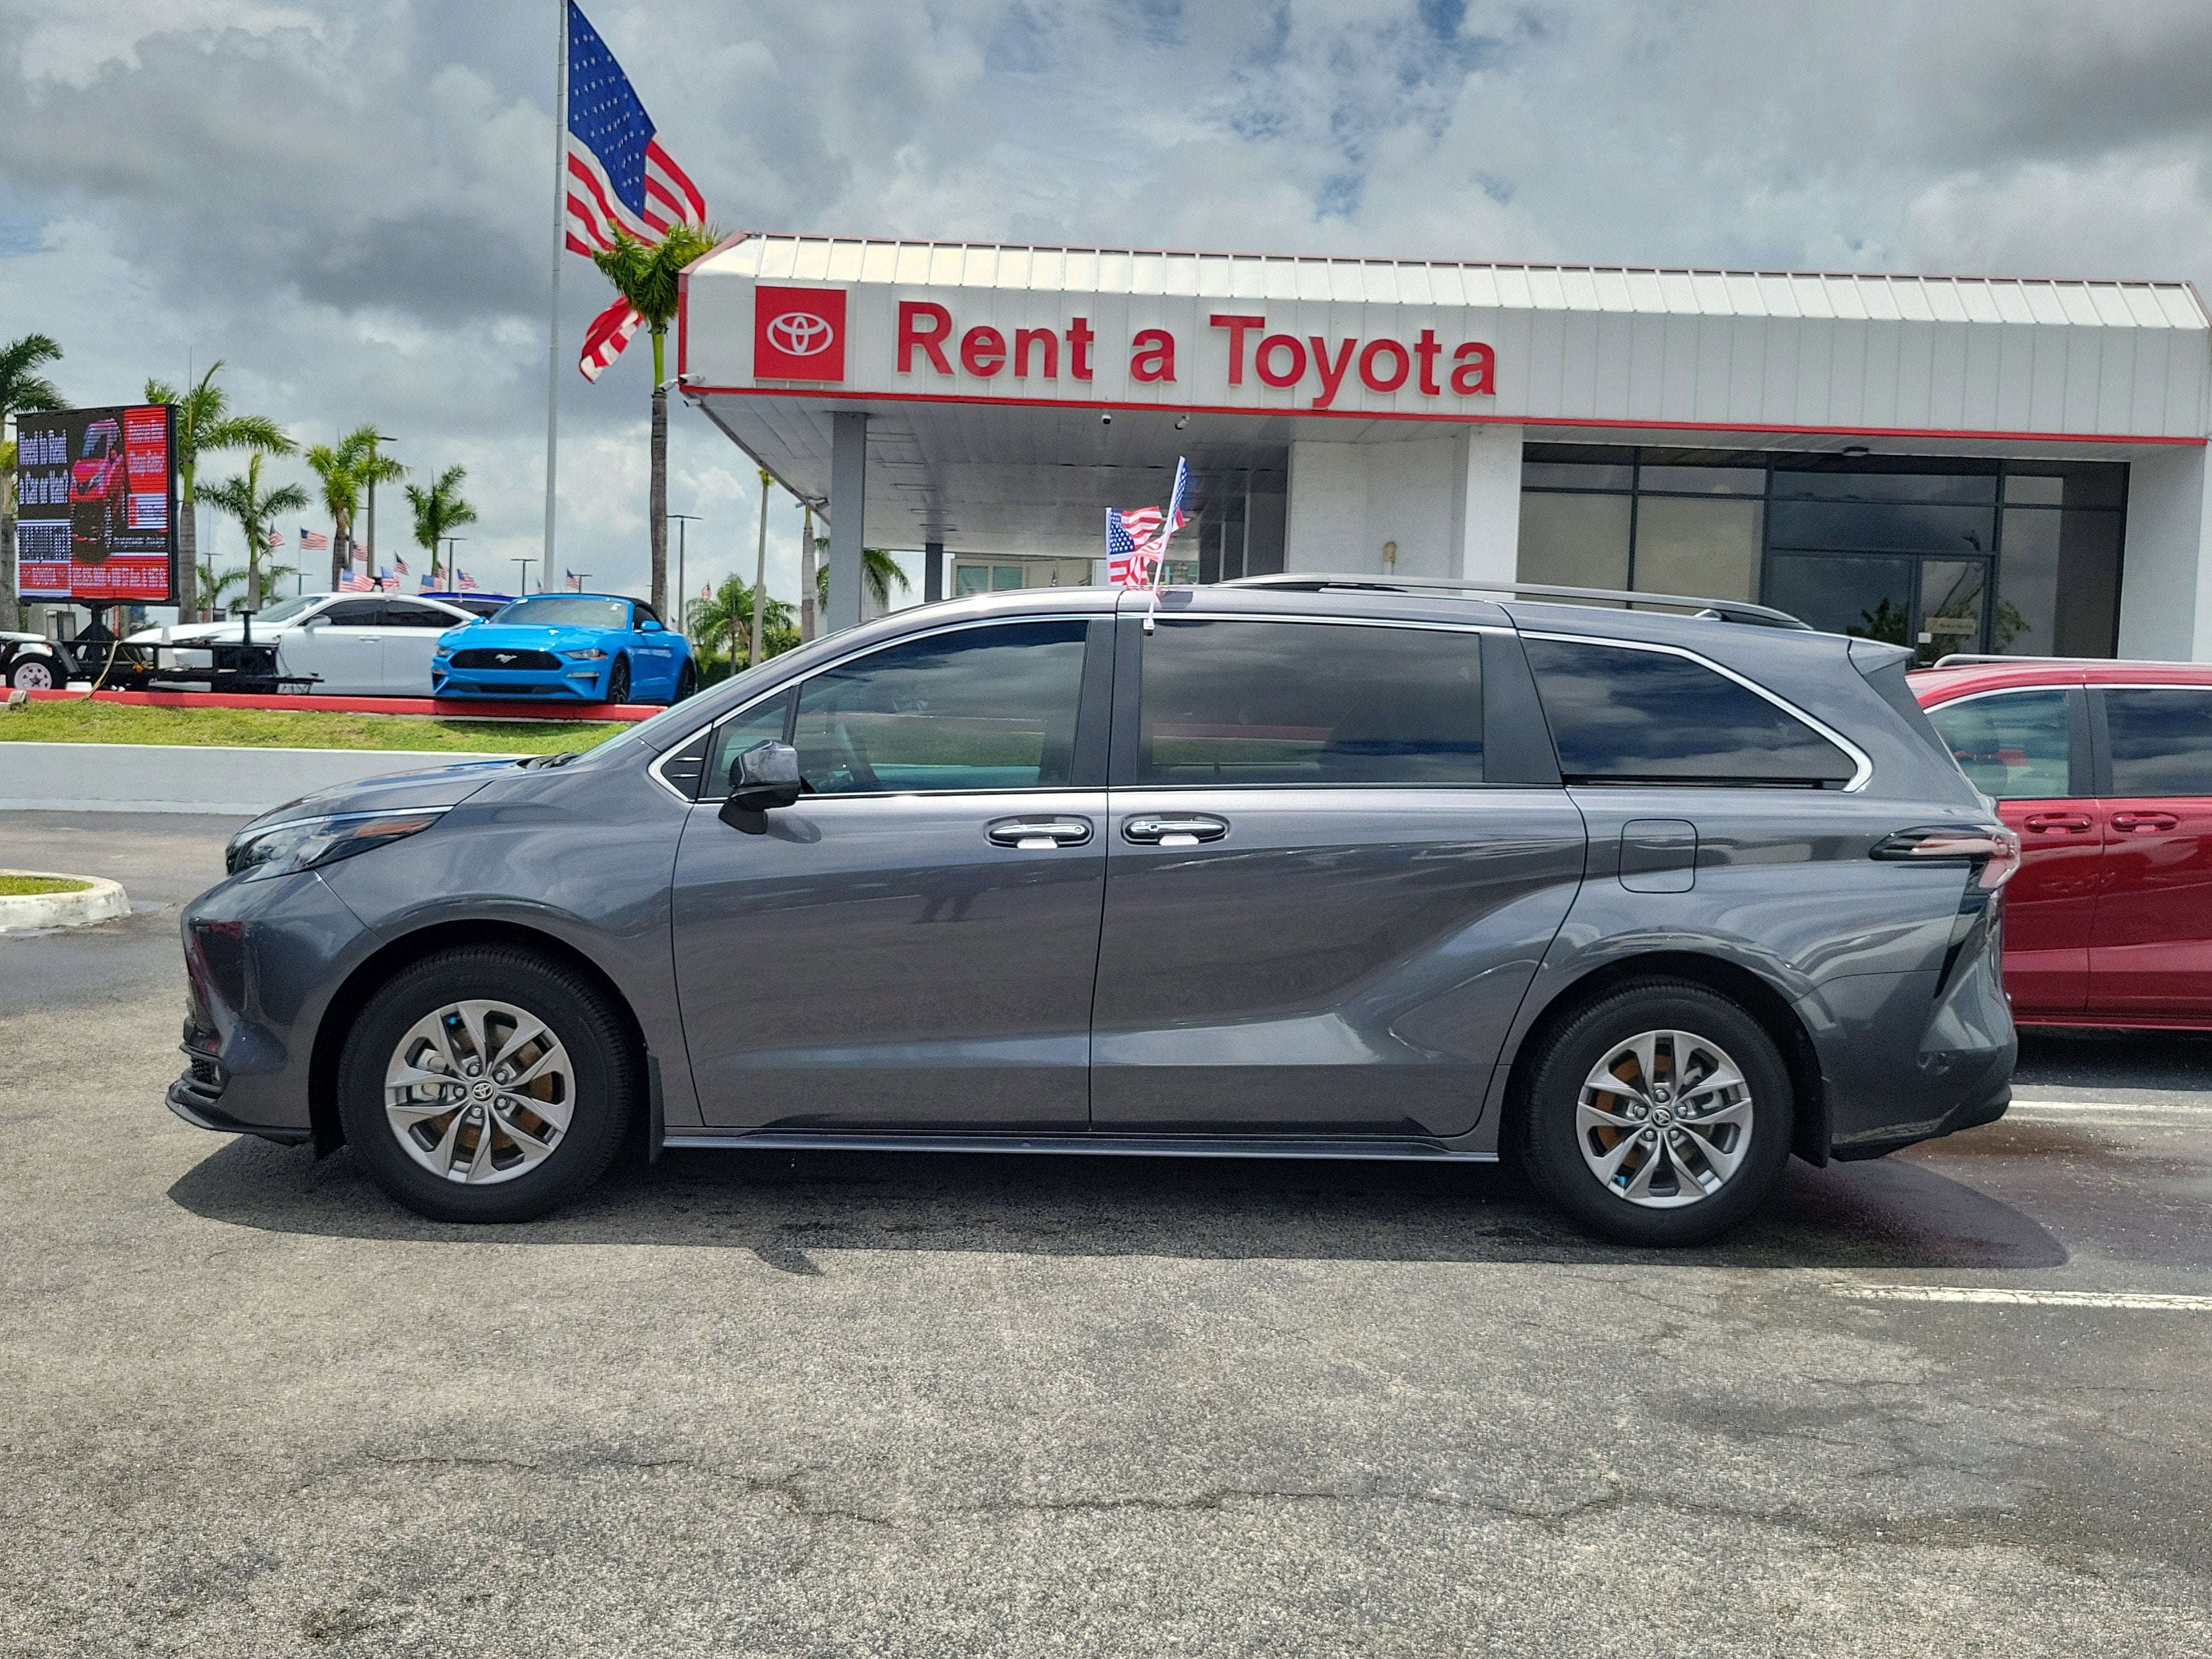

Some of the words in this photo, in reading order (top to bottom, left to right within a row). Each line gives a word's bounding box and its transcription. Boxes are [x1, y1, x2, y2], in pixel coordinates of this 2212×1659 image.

[897, 301, 1093, 382] Rent
[1130, 329, 1177, 382] a
[1210, 314, 1497, 410] Toyota
